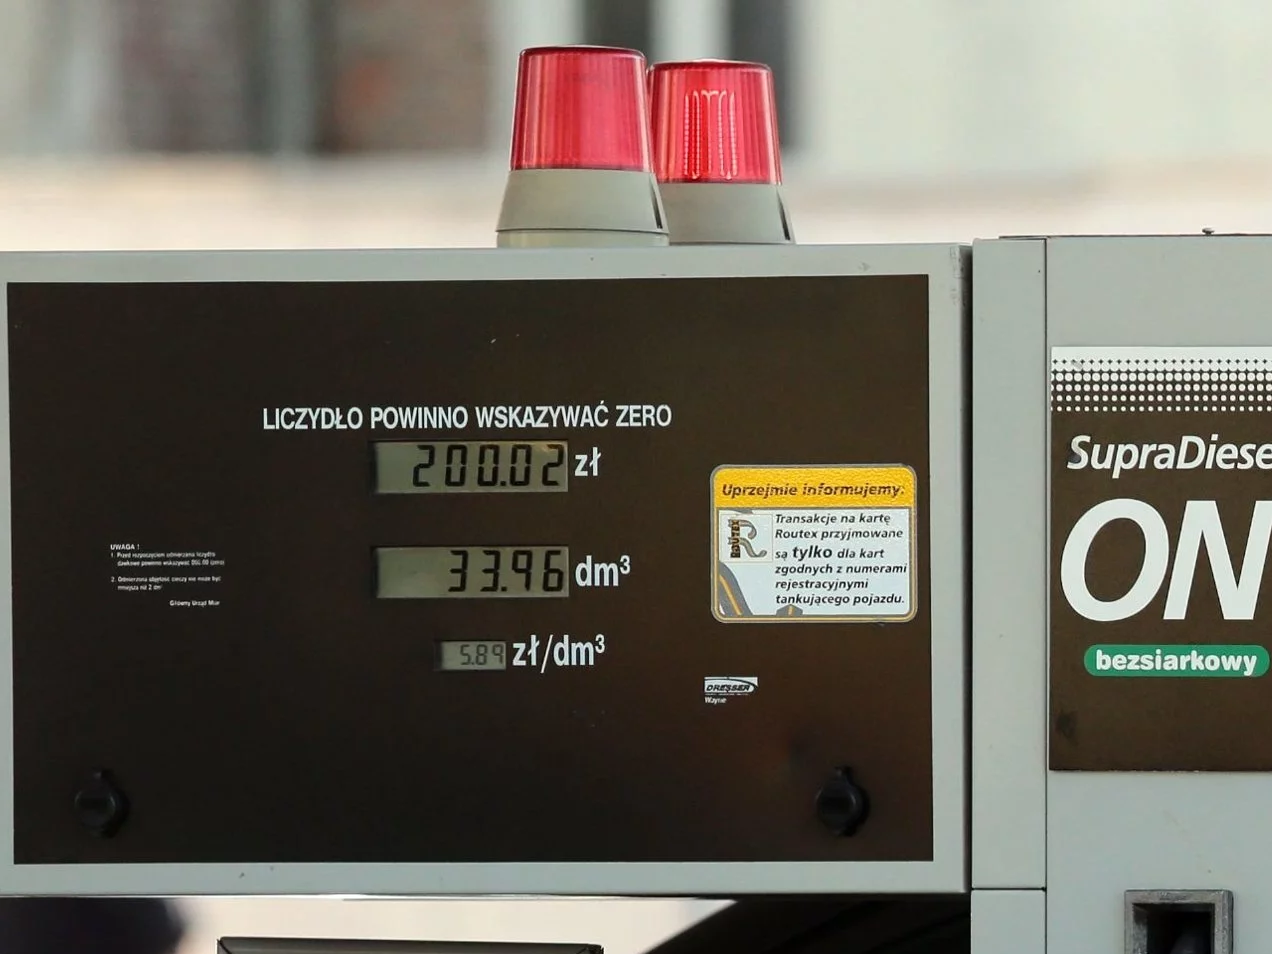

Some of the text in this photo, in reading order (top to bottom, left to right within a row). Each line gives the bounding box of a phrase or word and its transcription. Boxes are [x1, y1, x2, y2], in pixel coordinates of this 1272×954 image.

[263, 400, 672, 430] LICZYDŁO POWINNO WSKAZYWAĆ ZERO
[413, 444, 564, 487] 200.02
[574, 447, 601, 477] zł
[722, 483, 797, 498] Uprzejmie
[775, 513, 891, 526] Transakcje na kartę
[775, 529, 903, 541] Routex przyjmowane
[775, 545, 885, 561] są tylko dla kart
[448, 550, 564, 592] 33.96
[775, 563, 907, 576] zgodnych z numerami
[775, 579, 869, 591] rejestracyjnymi
[776, 593, 905, 606] tankującego pojazdu.
[1096, 649, 1257, 676] bezsiarkowy
